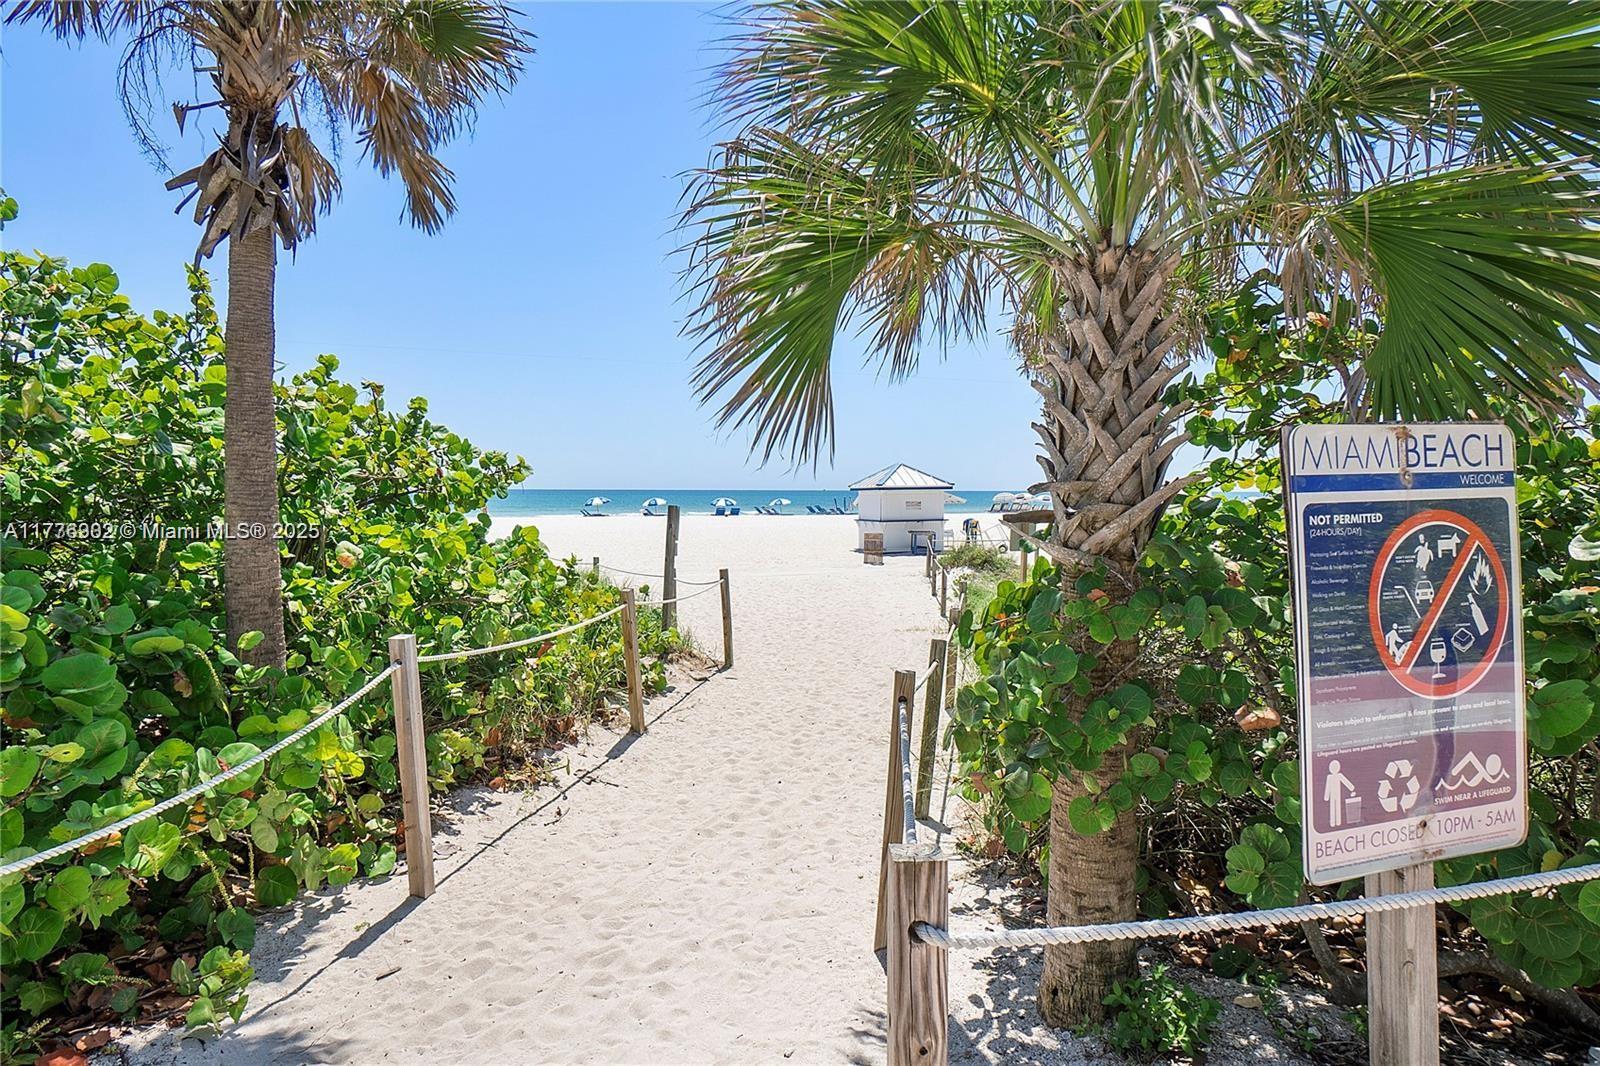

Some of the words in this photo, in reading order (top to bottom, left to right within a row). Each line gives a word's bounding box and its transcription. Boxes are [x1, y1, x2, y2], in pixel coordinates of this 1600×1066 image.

[1460, 473, 1505, 485] WELCOME
[1309, 514, 1331, 525] NOT
[1333, 512, 1383, 525] PERMITTED
[1434, 796, 1453, 805] SWIM
[1454, 793, 1471, 801] NEAR
[1479, 786, 1512, 798] LIFEGUARD
[1316, 834, 1366, 858] BEACH
[1370, 825, 1425, 848] CLOSED
[1437, 815, 1474, 836] 10PM
[1485, 808, 1516, 826] 5AM
